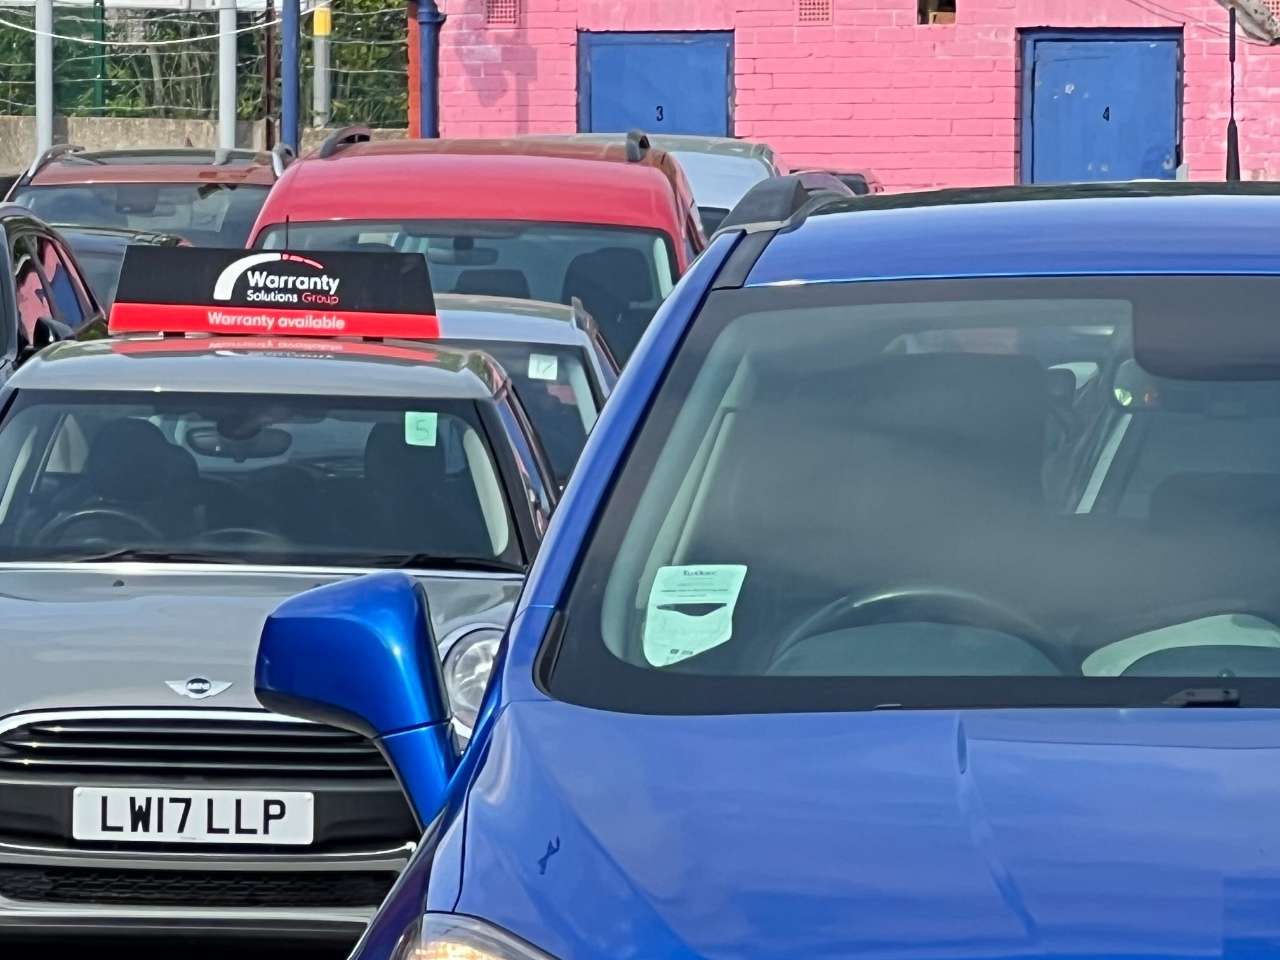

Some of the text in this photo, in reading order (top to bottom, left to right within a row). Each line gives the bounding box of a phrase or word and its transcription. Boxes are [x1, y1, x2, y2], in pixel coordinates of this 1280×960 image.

[656, 105, 664, 122] 3
[247, 270, 340, 293] Warranty
[246, 290, 339, 305] Solutions Group
[208, 311, 346, 330] Warranty available
[207, 798, 286, 835] LLP
